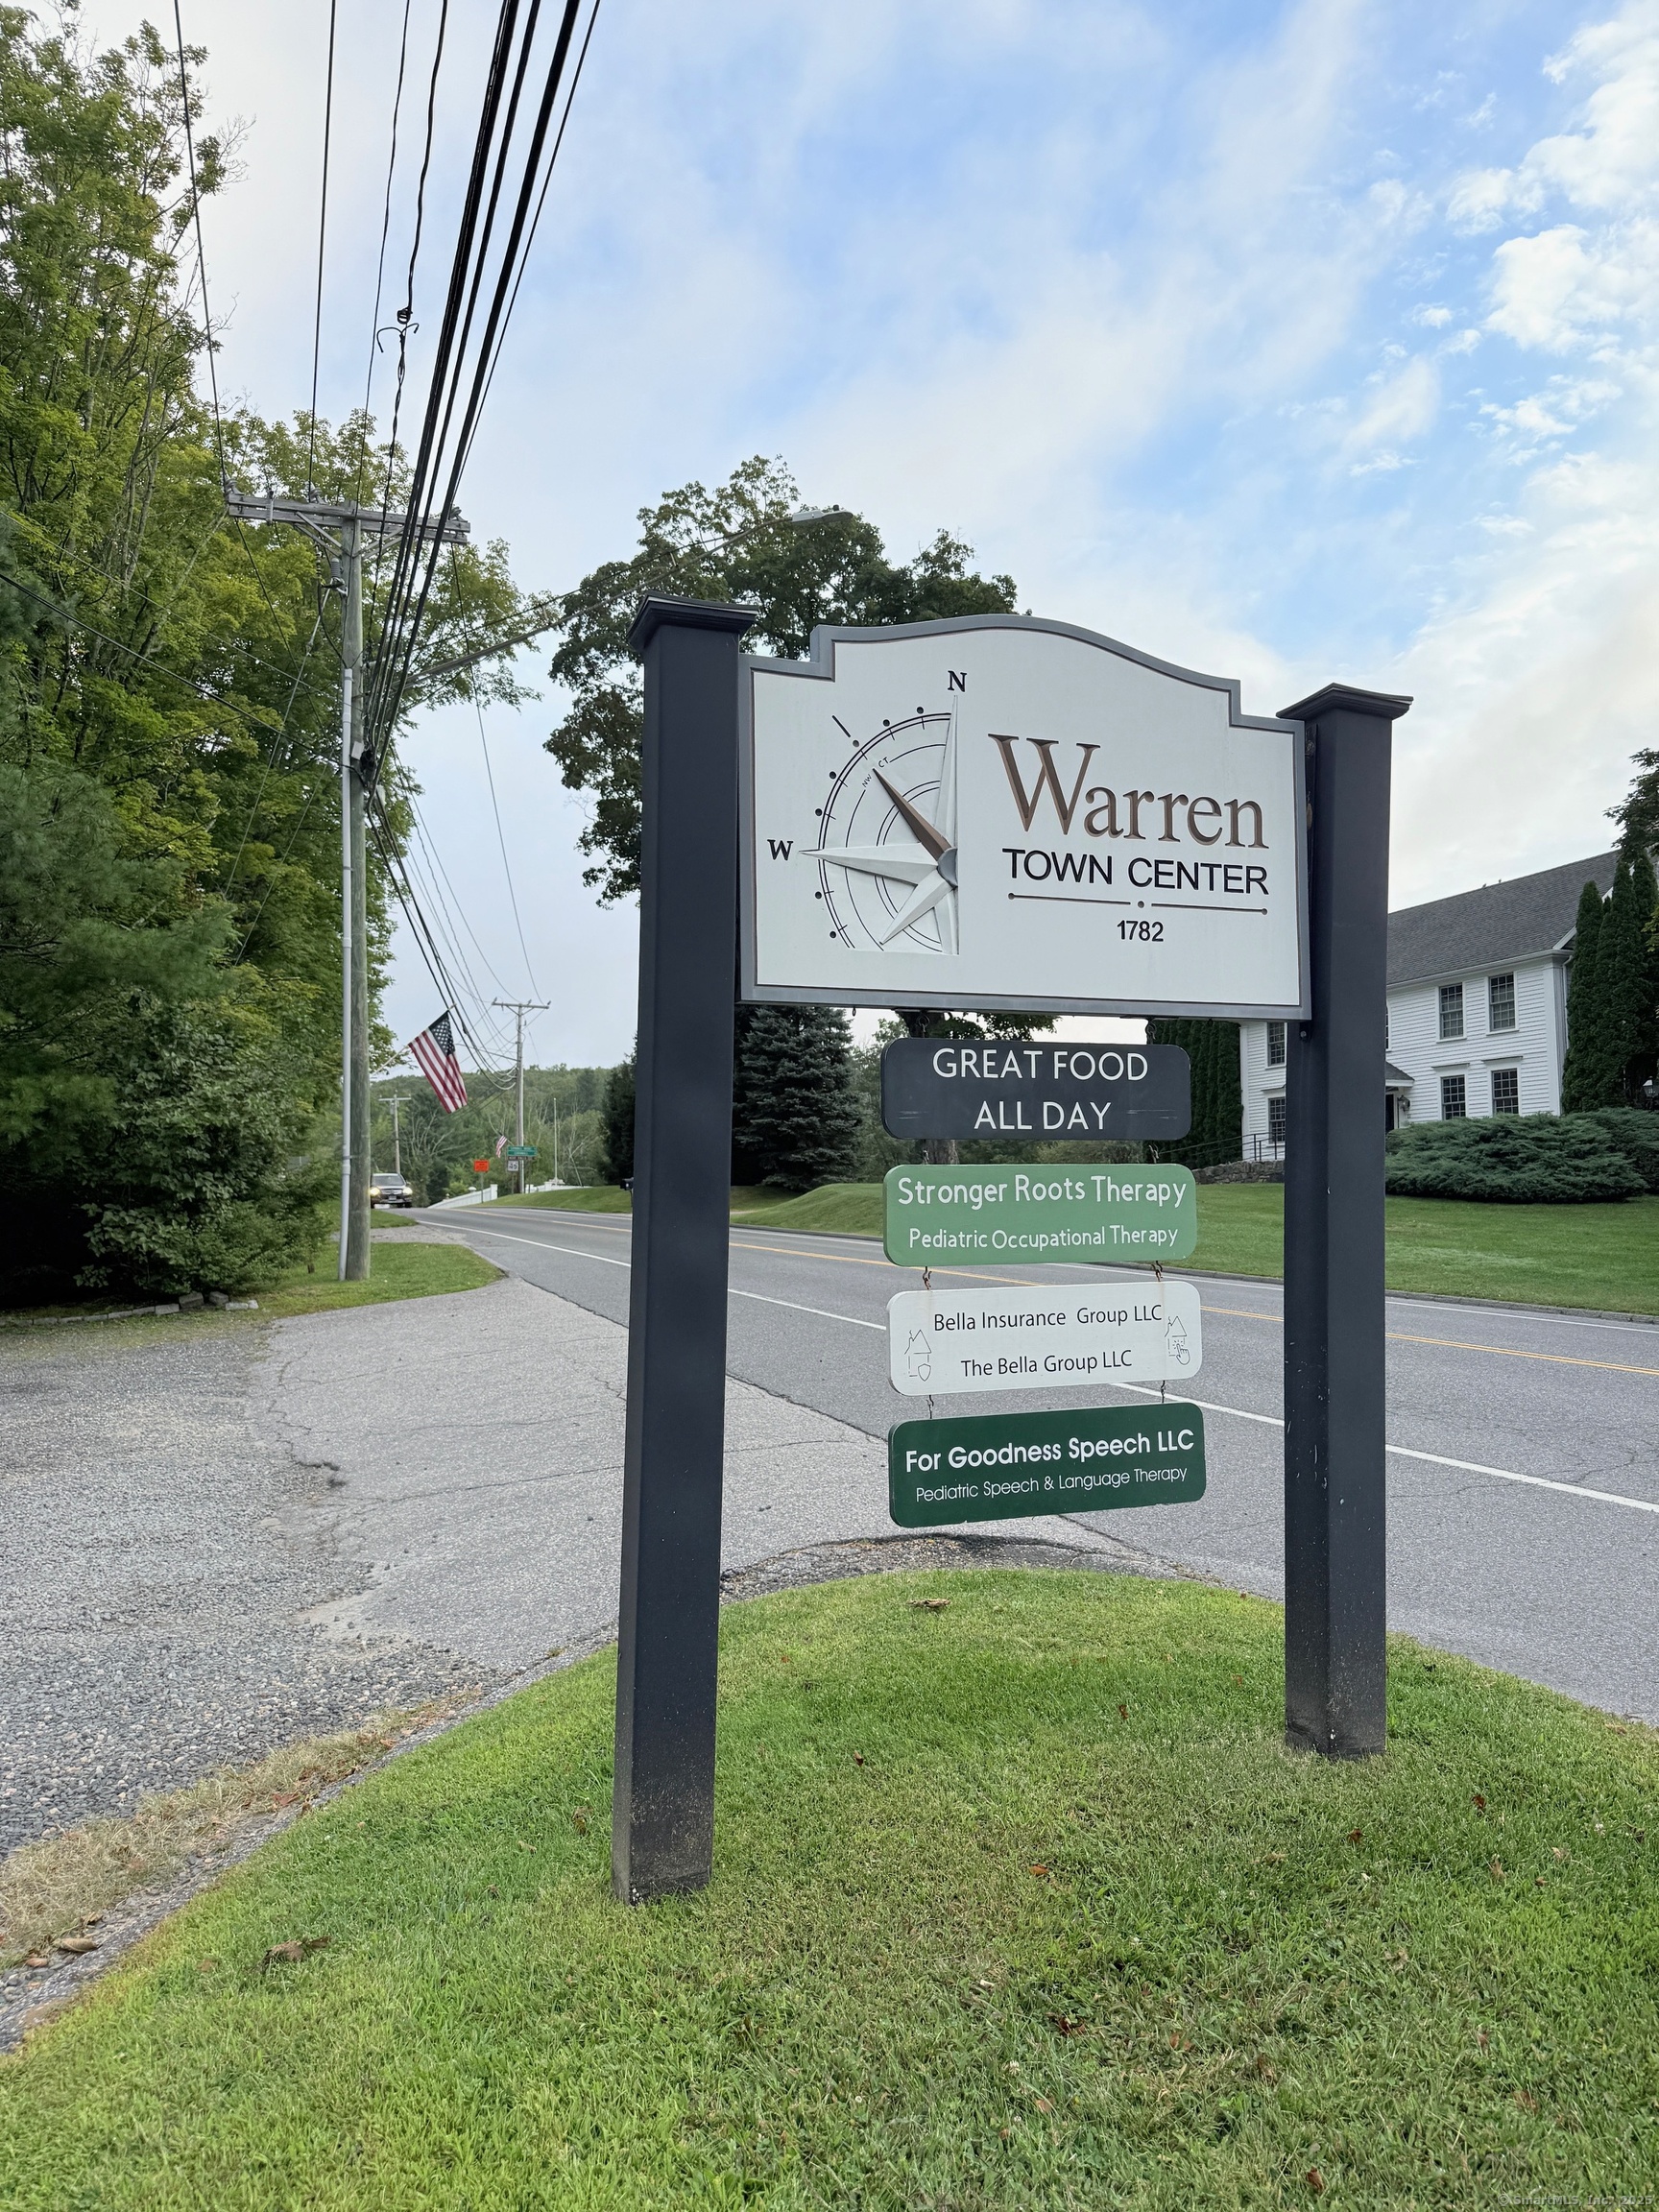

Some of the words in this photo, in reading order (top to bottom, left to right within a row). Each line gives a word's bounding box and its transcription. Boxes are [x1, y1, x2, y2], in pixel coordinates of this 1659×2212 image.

[947, 670, 967, 692] N
[861, 773, 872, 787] NW
[878, 757, 888, 768] CT
[987, 733, 1269, 849] Warren
[767, 839, 793, 861] W
[1002, 848, 1113, 885] TOWN
[1128, 857, 1269, 895] CENTER
[1117, 920, 1165, 942] 1782
[932, 1047, 1044, 1079] GREAT
[1054, 1050, 1148, 1081] FOOD
[974, 1100, 1032, 1130] ALL
[1043, 1101, 1112, 1130] DAY
[898, 1177, 1007, 1211] Stronger
[1015, 1174, 1085, 1201] Roots
[1091, 1175, 1187, 1208] Therapy
[909, 1228, 988, 1248] Pediatric
[992, 1226, 1105, 1252] Occupational
[1110, 1225, 1178, 1247] Therapy
[934, 1311, 975, 1332] Bella
[982, 1310, 1067, 1329] Insurance
[1077, 1305, 1128, 1327] Group
[1134, 1304, 1163, 1322] LLC
[961, 1358, 993, 1378] The
[998, 1354, 1038, 1374] Bella
[1044, 1352, 1098, 1374] Group
[1102, 1350, 1132, 1368] LLC
[905, 1450, 942, 1473] For
[948, 1443, 1062, 1469] Goodness
[1069, 1432, 1150, 1463] Speech
[1158, 1429, 1194, 1452] LLC
[916, 1479, 978, 1503] Pediatric
[983, 1477, 1039, 1498] Speech
[1044, 1476, 1054, 1490] &
[1059, 1469, 1130, 1491] Language
[1134, 1465, 1188, 1482] Therapy
